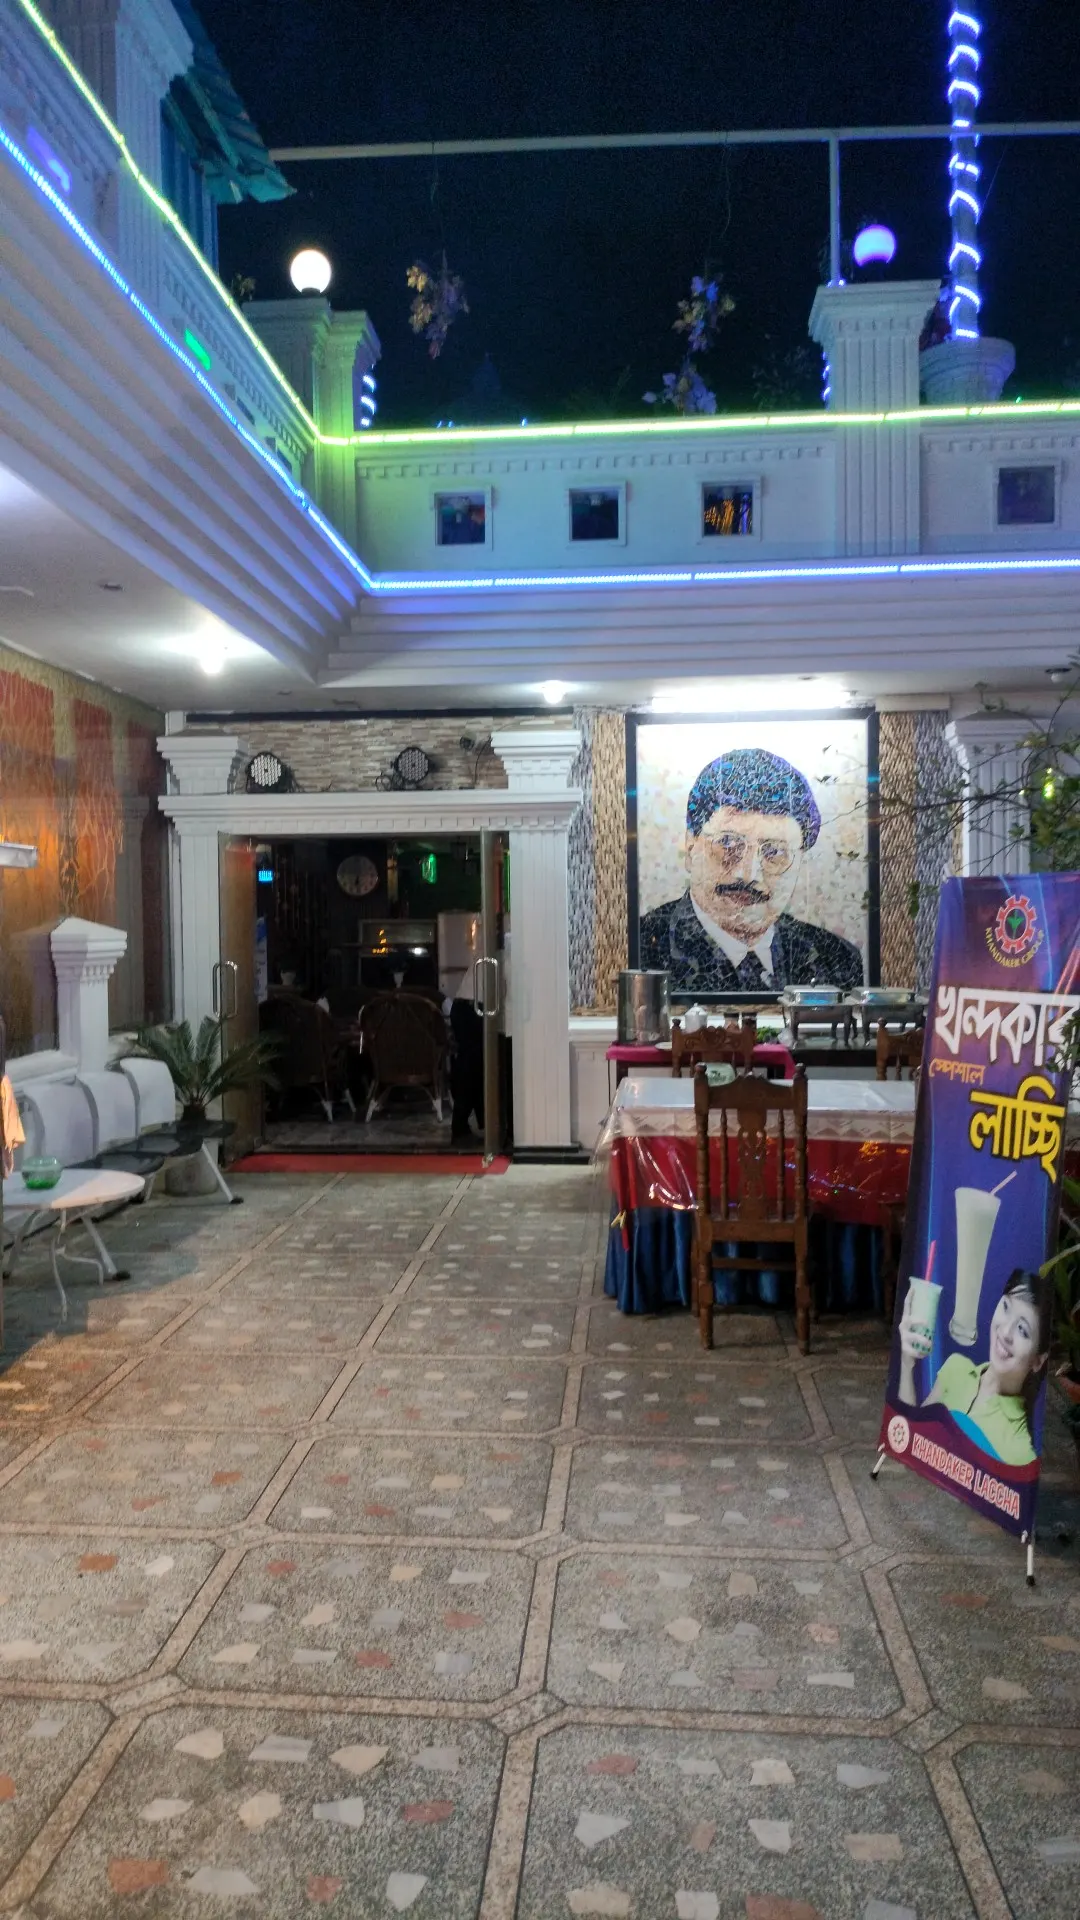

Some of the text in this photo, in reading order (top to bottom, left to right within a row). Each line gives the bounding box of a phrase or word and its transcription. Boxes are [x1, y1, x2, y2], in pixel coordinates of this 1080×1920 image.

[985, 927, 1020, 967] KHANDAKER
[929, 1058, 986, 1086] স্পেশাল
[970, 1075, 1065, 1184] লাচ্ছি
[911, 1432, 1020, 1520] KHANDAKER LACCHA
